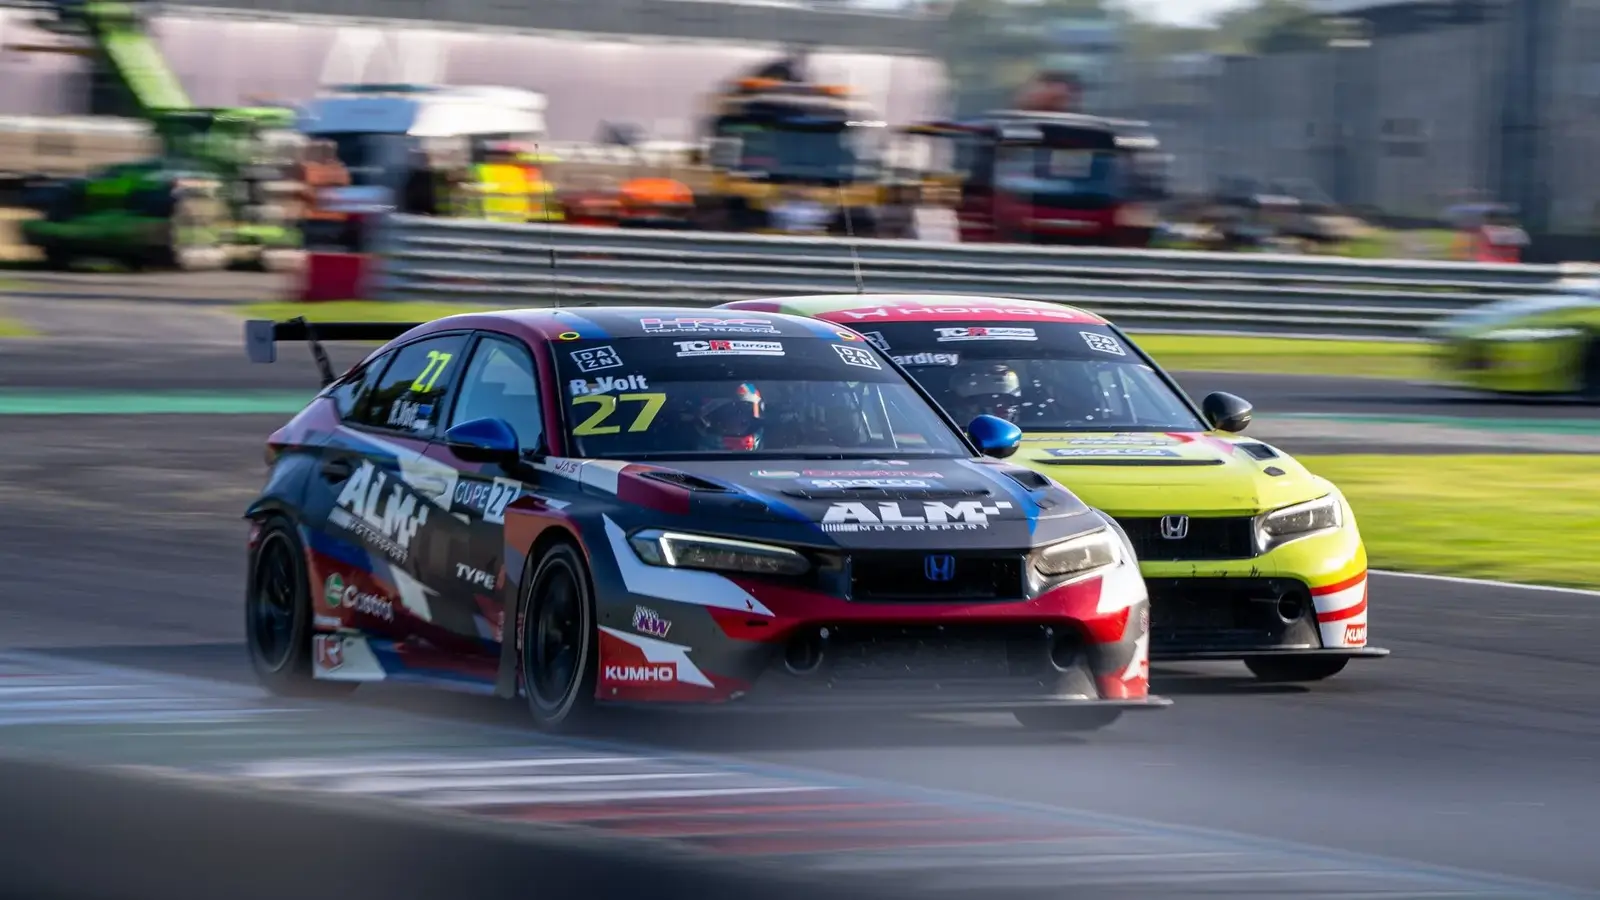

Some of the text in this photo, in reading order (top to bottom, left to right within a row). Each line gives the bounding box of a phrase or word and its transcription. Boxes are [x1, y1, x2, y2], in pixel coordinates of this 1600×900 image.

[673, 340, 781, 352] TCR Europe
[892, 352, 960, 366] ardley
[409, 351, 453, 393] 27
[572, 393, 667, 435] 27
[336, 459, 420, 549] ALM
[486, 482, 518, 517] 27
[822, 501, 990, 524] ALM
[858, 523, 990, 532] MOTORSPORT
[456, 562, 497, 591] TYPE
[637, 614, 671, 638] KW
[1345, 627, 1365, 641] KUM
[606, 665, 673, 681] KUMHO
